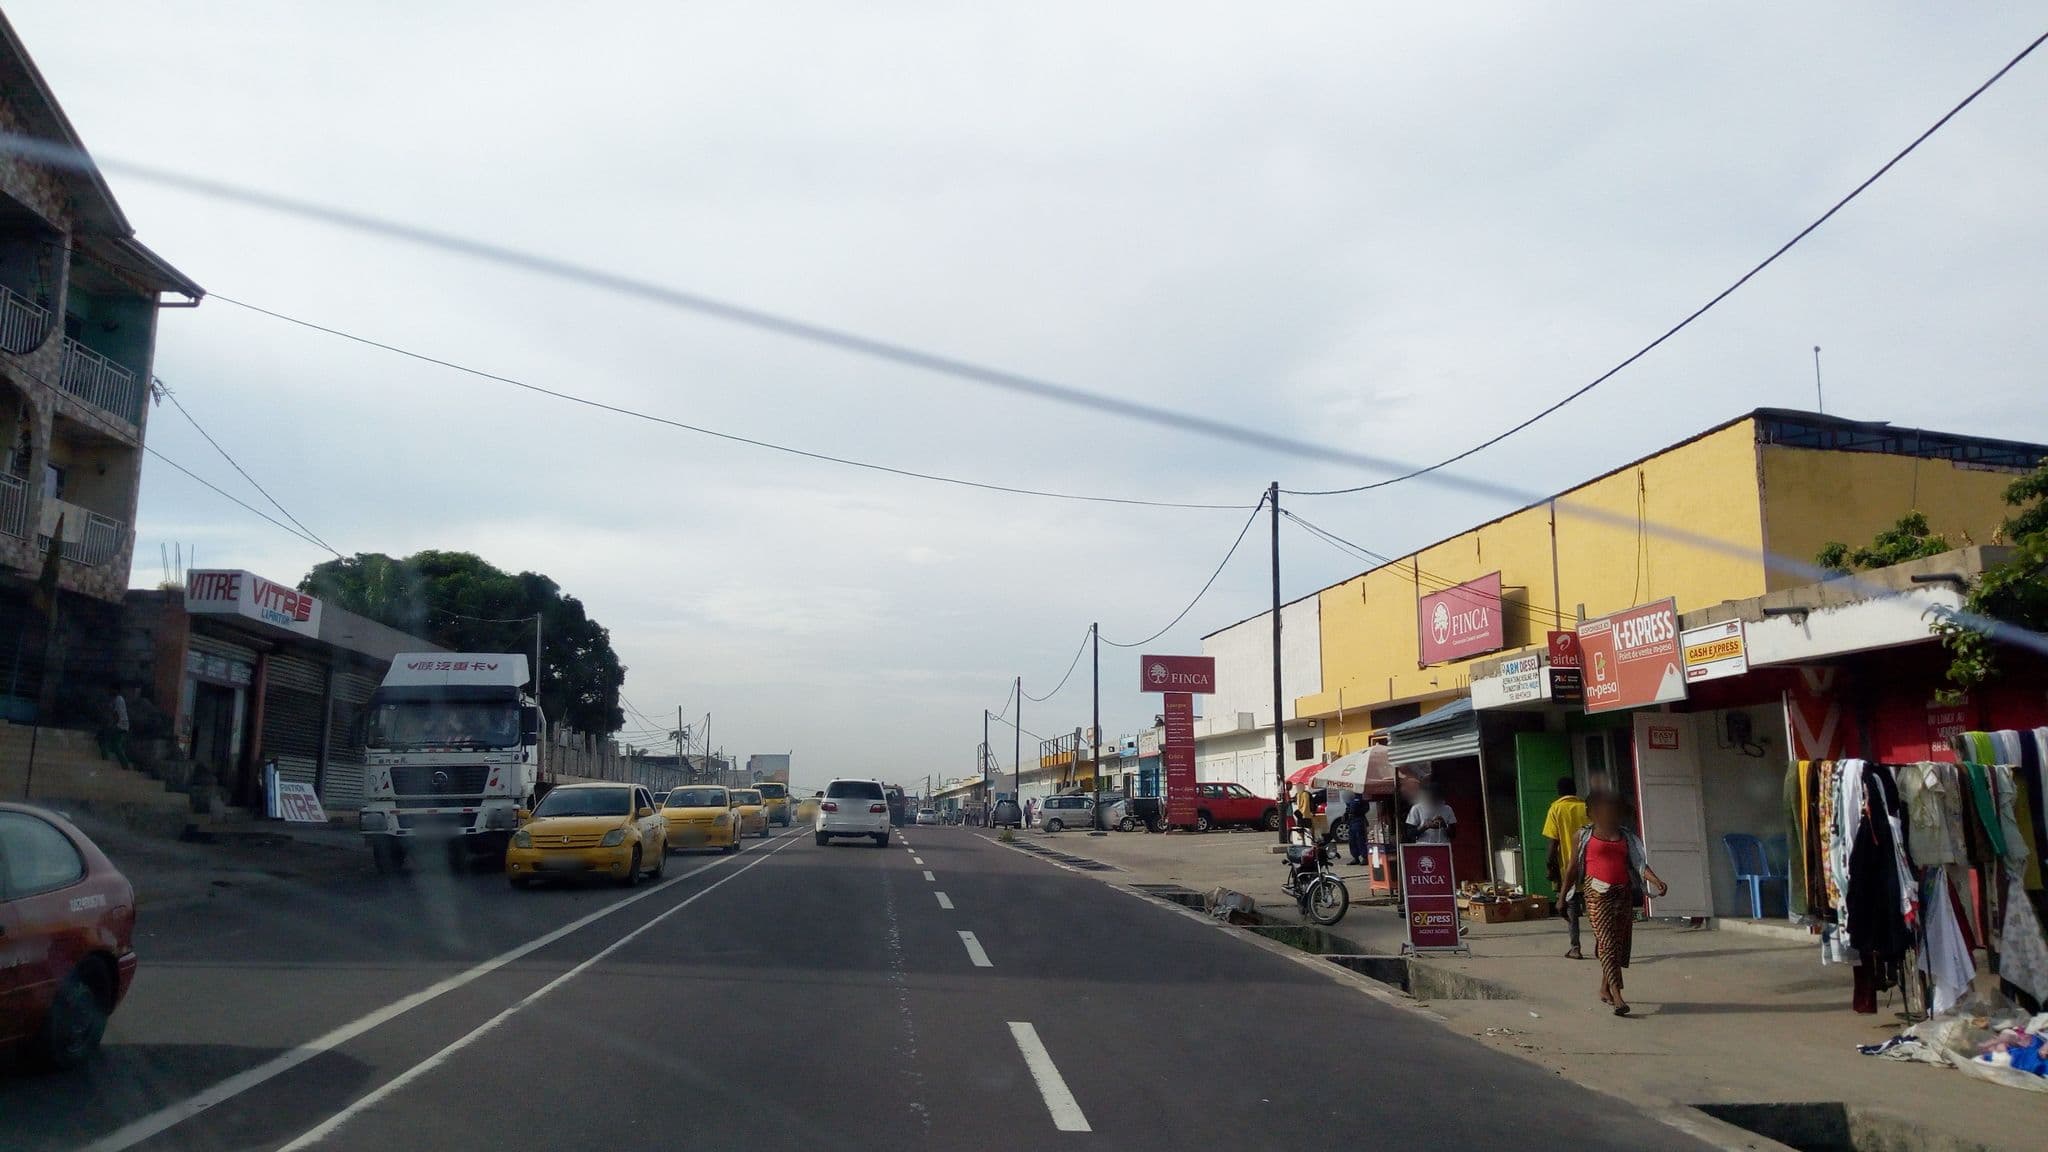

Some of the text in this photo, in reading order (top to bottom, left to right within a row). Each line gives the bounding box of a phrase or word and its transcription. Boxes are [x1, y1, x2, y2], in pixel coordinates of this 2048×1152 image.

[190, 573, 241, 600] VITRE
[253, 577, 312, 621] VITRE
[1452, 607, 1489, 636] FINCA
[1612, 610, 1674, 651] K-EXPRESS
[1690, 647, 1707, 659] CASH
[1709, 640, 1739, 657] EXPRESS
[1520, 658, 1537, 673] DIESEL
[1553, 655, 1580, 665] airtel
[1171, 673, 1208, 684] FINCA
[1410, 875, 1445, 885] FINCA
